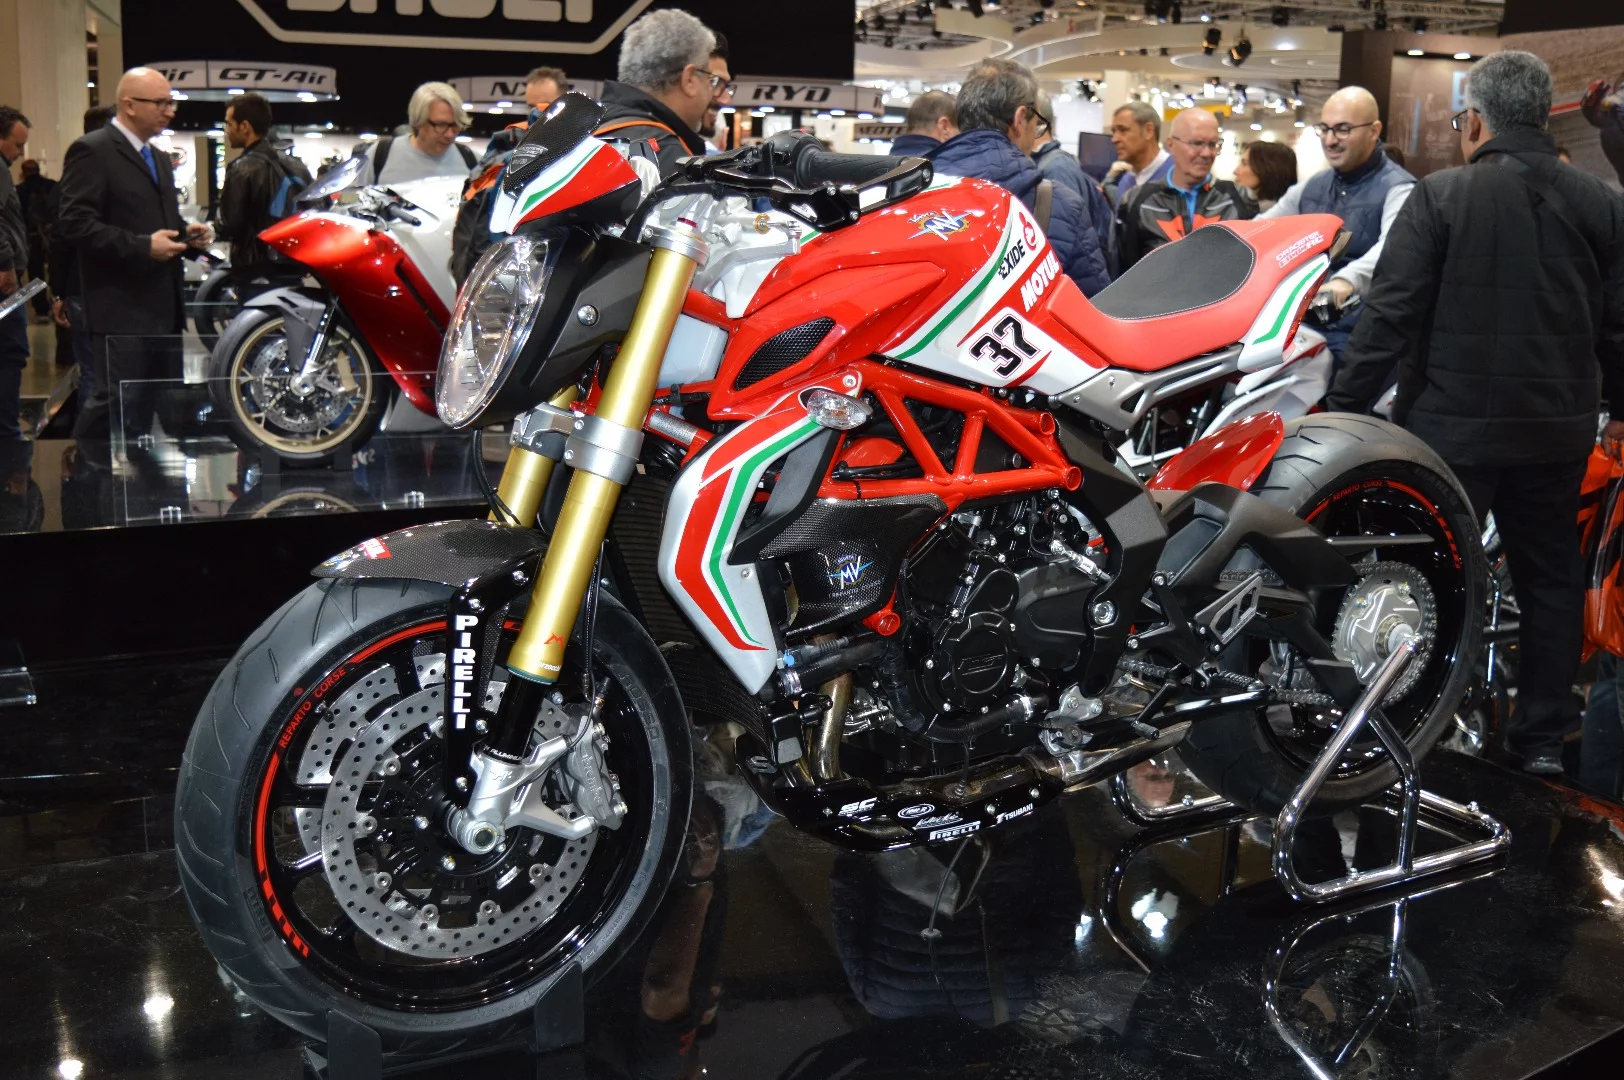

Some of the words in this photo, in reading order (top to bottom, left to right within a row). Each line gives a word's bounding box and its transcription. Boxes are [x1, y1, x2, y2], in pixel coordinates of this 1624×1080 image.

[219, 68, 327, 85] GT-Air
[998, 239, 1026, 280] EXIDE
[1020, 249, 1060, 312] MOTUL
[969, 314, 1041, 379] 37
[453, 615, 478, 729] PIRELLI
[278, 701, 312, 748] REPARTO
[314, 666, 346, 698] CORSE
[929, 820, 981, 841] PIRELLI
[1004, 803, 1034, 820] TSUBAKI
